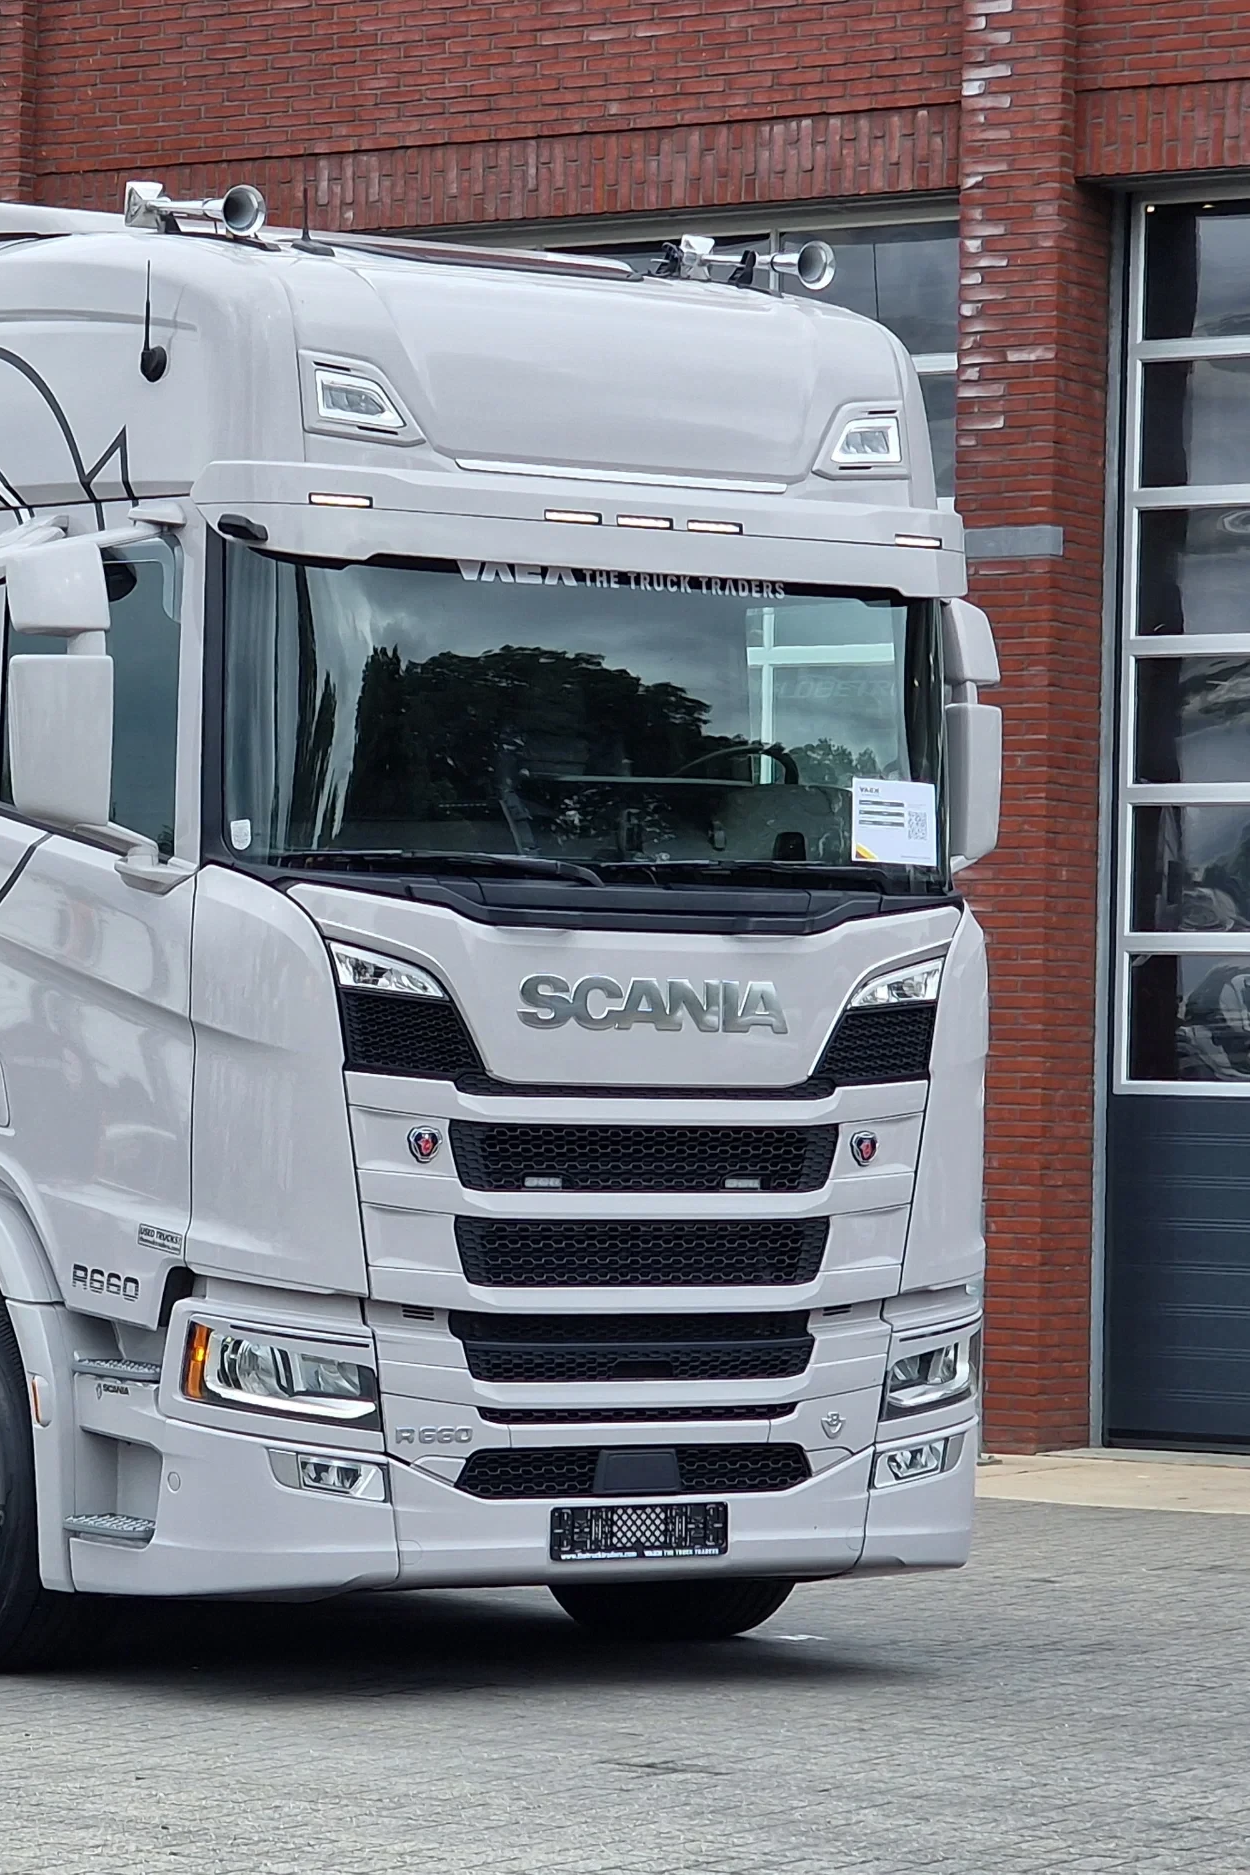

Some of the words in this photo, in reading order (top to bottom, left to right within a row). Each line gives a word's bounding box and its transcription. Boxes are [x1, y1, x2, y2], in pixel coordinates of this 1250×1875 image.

[582, 569, 620, 588] THE
[627, 572, 692, 594] TRUCK
[699, 576, 785, 599] TRADERS
[516, 973, 789, 1034] SCANIA
[140, 1227, 155, 1238] USED
[72, 1263, 140, 1303] R660
